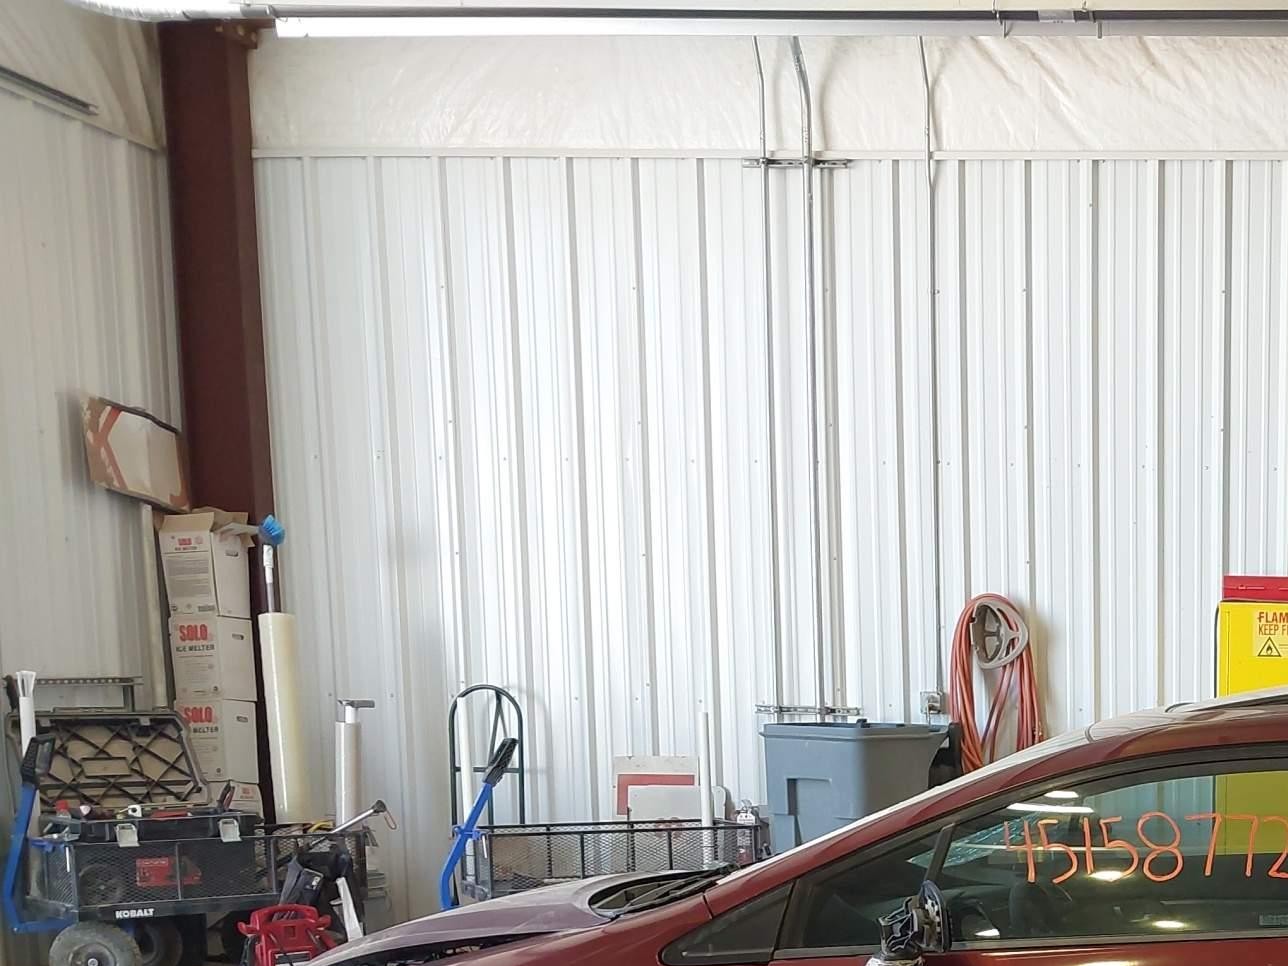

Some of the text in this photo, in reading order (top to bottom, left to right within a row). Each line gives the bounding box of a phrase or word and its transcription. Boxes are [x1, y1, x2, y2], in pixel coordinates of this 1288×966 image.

[178, 623, 208, 642] SOLO
[1258, 624, 1279, 636] KEEP
[188, 644, 215, 652] MELTER
[183, 705, 213, 724] SOLO
[115, 908, 155, 919] KOBALT
